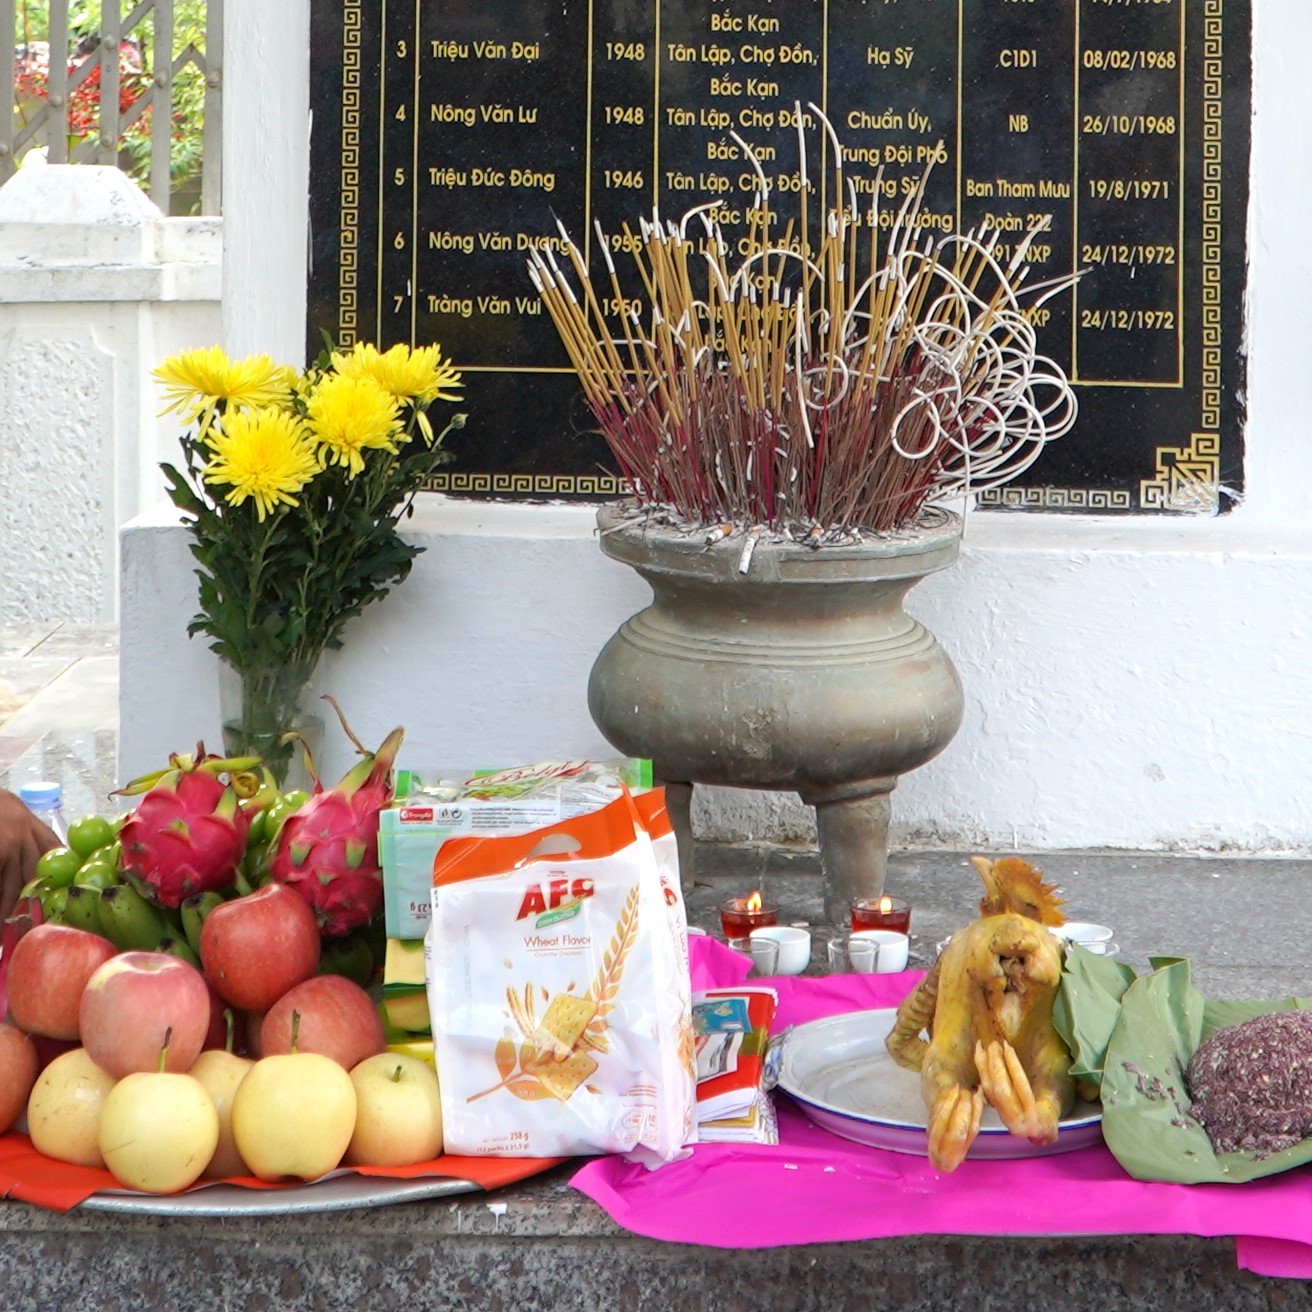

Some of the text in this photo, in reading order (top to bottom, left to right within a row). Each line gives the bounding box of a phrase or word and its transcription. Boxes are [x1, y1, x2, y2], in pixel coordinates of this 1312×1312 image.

[711, 8, 780, 37] Bắc Kạn
[396, 40, 407, 58] 3
[430, 40, 540, 64] Triệu Văn Đại
[606, 42, 646, 62] 1948
[667, 42, 818, 67] Tân Lập, Chợ Đồn,
[867, 46, 915, 69] Hạ Sỹ
[1083, 49, 1177, 71] 08/02/1968
[710, 72, 779, 101] Bắc Kạn
[395, 104, 406, 122] 4
[431, 104, 538, 127] Nông Văn Lư
[605, 106, 645, 125] 1948
[666, 107, 775, 132] Tân Lập, Chợ
[847, 107, 903, 130] Chuẩn
[1008, 114, 1029, 133] NB
[1082, 115, 1176, 136] 26/10/1968
[706, 137, 740, 161] Bắc
[883, 144, 913, 168] Đội
[394, 167, 405, 186] 5
[428, 167, 555, 192] Triệu Đức Đông
[604, 170, 644, 189] 1946
[665, 171, 735, 195] Tân Lập,
[966, 178, 1071, 199] Ban Tham Mưu
[1089, 179, 1169, 201] 19/8/1971
[394, 231, 405, 250] 6
[429, 231, 512, 255] Nông Văn
[1082, 244, 1175, 266] 24/12/1972
[393, 295, 403, 313] 7
[427, 293, 541, 318] Tràng Văn Vui
[1081, 309, 1174, 331] 24/12/1972
[524, 935, 559, 948] Wheat
